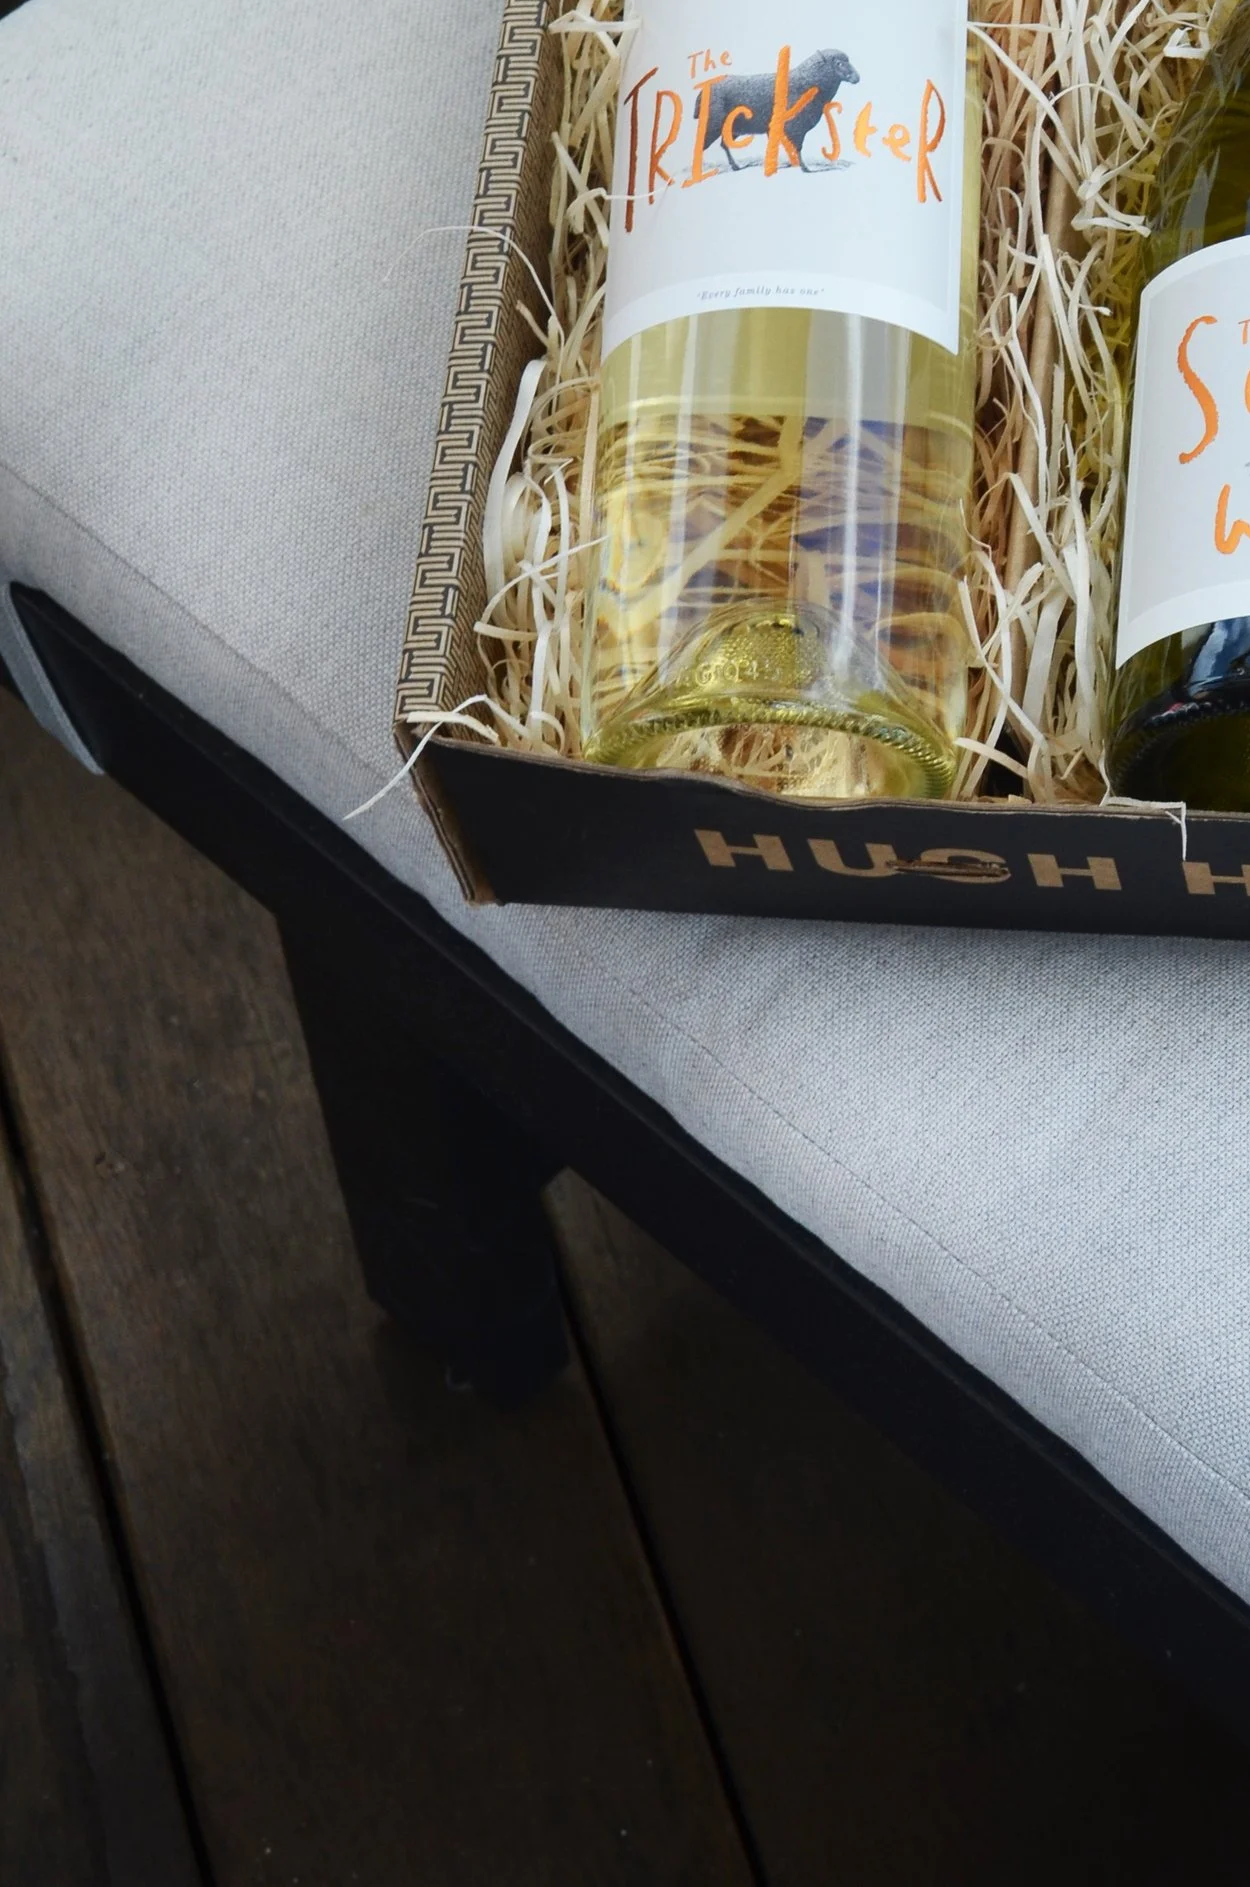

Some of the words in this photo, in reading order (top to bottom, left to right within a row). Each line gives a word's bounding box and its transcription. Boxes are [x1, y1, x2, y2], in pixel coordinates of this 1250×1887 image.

[687, 48, 734, 80] The
[733, 284, 772, 299] family
[775, 284, 796, 296] has
[693, 828, 1123, 892] HUGH
